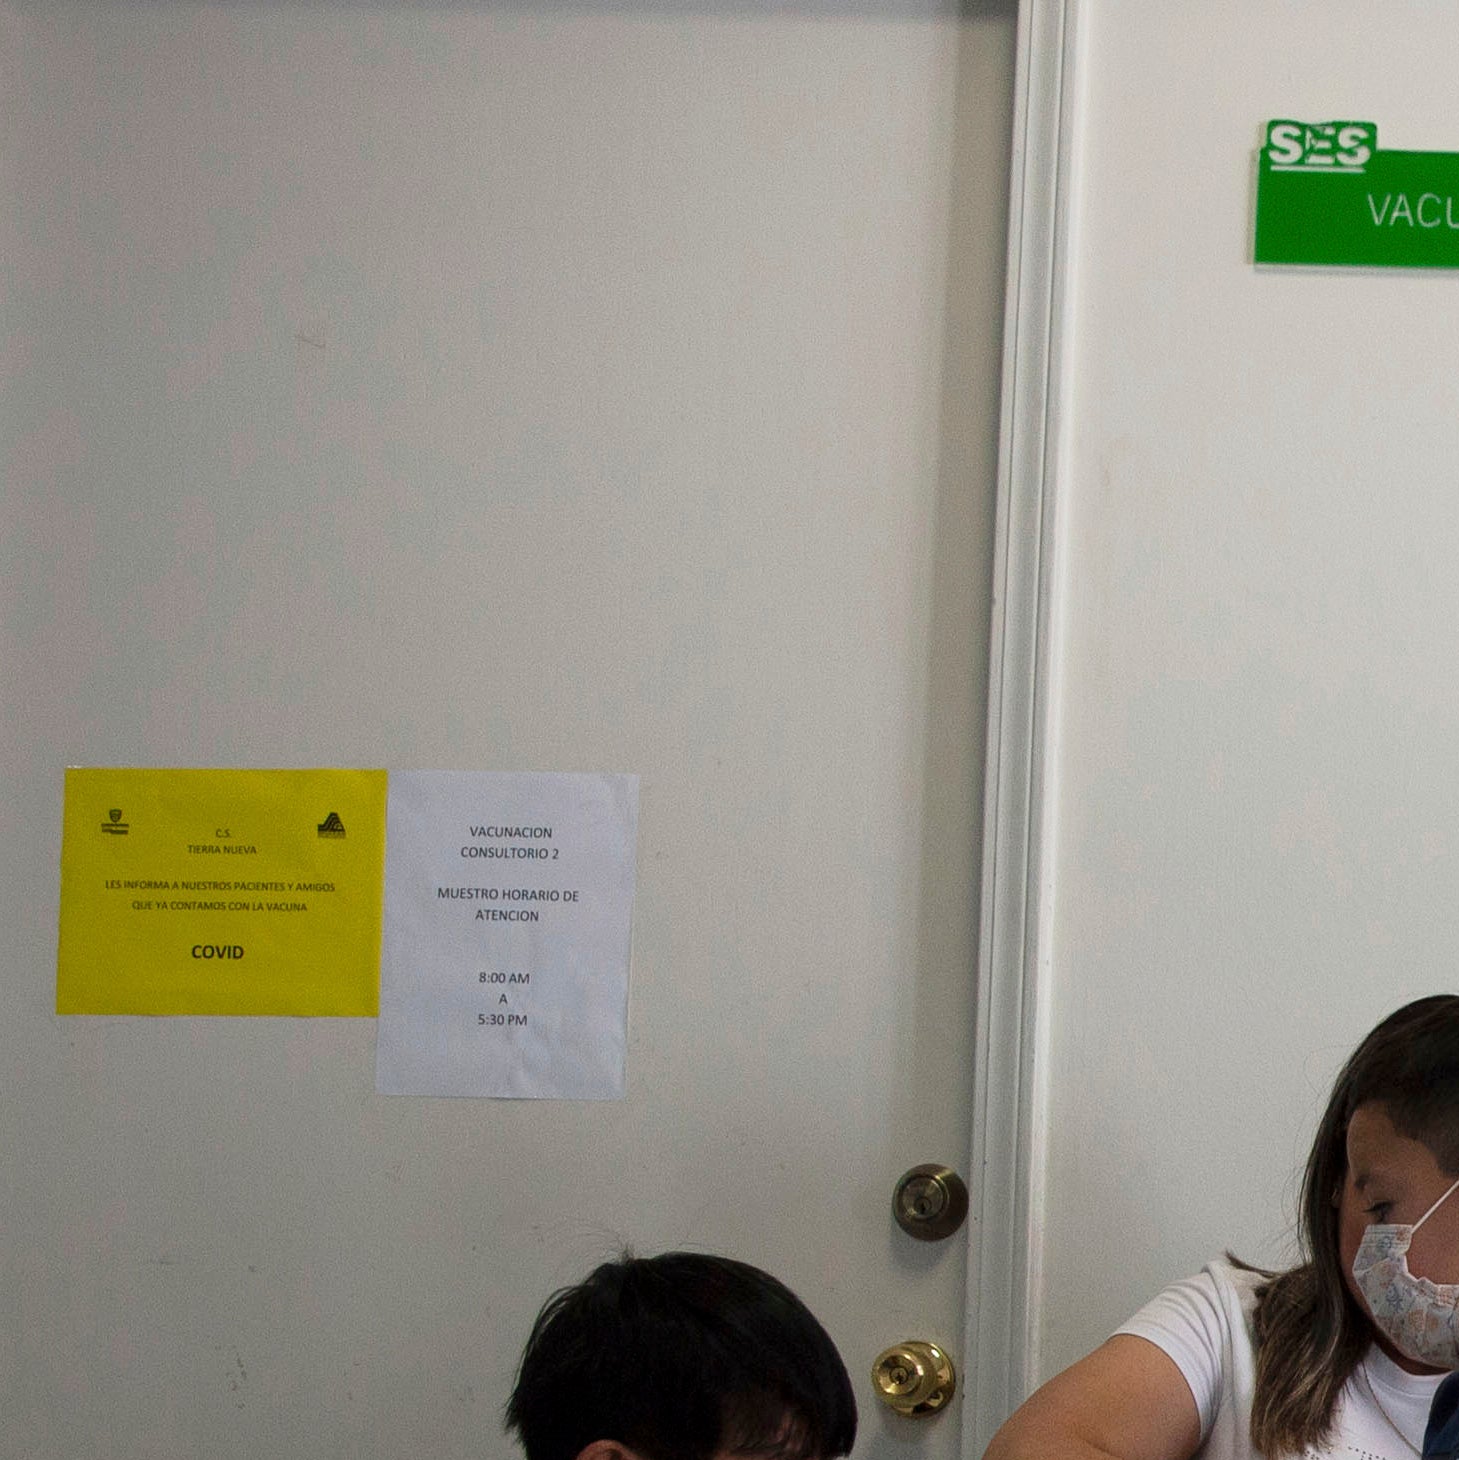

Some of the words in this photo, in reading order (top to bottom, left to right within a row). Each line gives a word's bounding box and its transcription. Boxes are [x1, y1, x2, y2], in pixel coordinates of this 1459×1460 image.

[1269, 124, 1371, 166] SES
[470, 826, 552, 838] VACUNACION
[188, 845, 220, 854] TIERRA
[224, 845, 256, 854] NUEVA
[461, 847, 548, 859] CONSULTORIO
[552, 849, 559, 859] 2
[105, 880, 121, 889] LES
[124, 881, 170, 890] INFORMA
[172, 881, 179, 890] A
[181, 881, 231, 890] NUESTROS
[234, 882, 285, 891] PACIENTES
[288, 882, 294, 891] Y
[296, 883, 335, 892] AMIGOS
[438, 888, 498, 899] MUESTRO
[502, 889, 559, 901] HORARIO
[563, 891, 579, 901] DE
[132, 902, 153, 911] QUE
[156, 902, 168, 910] YA
[171, 902, 226, 911] CONTAMOS
[229, 902, 249, 911] CON
[253, 903, 263, 911] LA
[266, 903, 307, 912] VACUNA
[475, 910, 539, 921] ATENCION
[192, 945, 244, 959] COVID
[479, 972, 505, 984] 8:00
[509, 973, 529, 984] AM
[499, 994, 508, 1004] A
[478, 1014, 504, 1025] 5:30
[508, 1015, 527, 1025] PM
